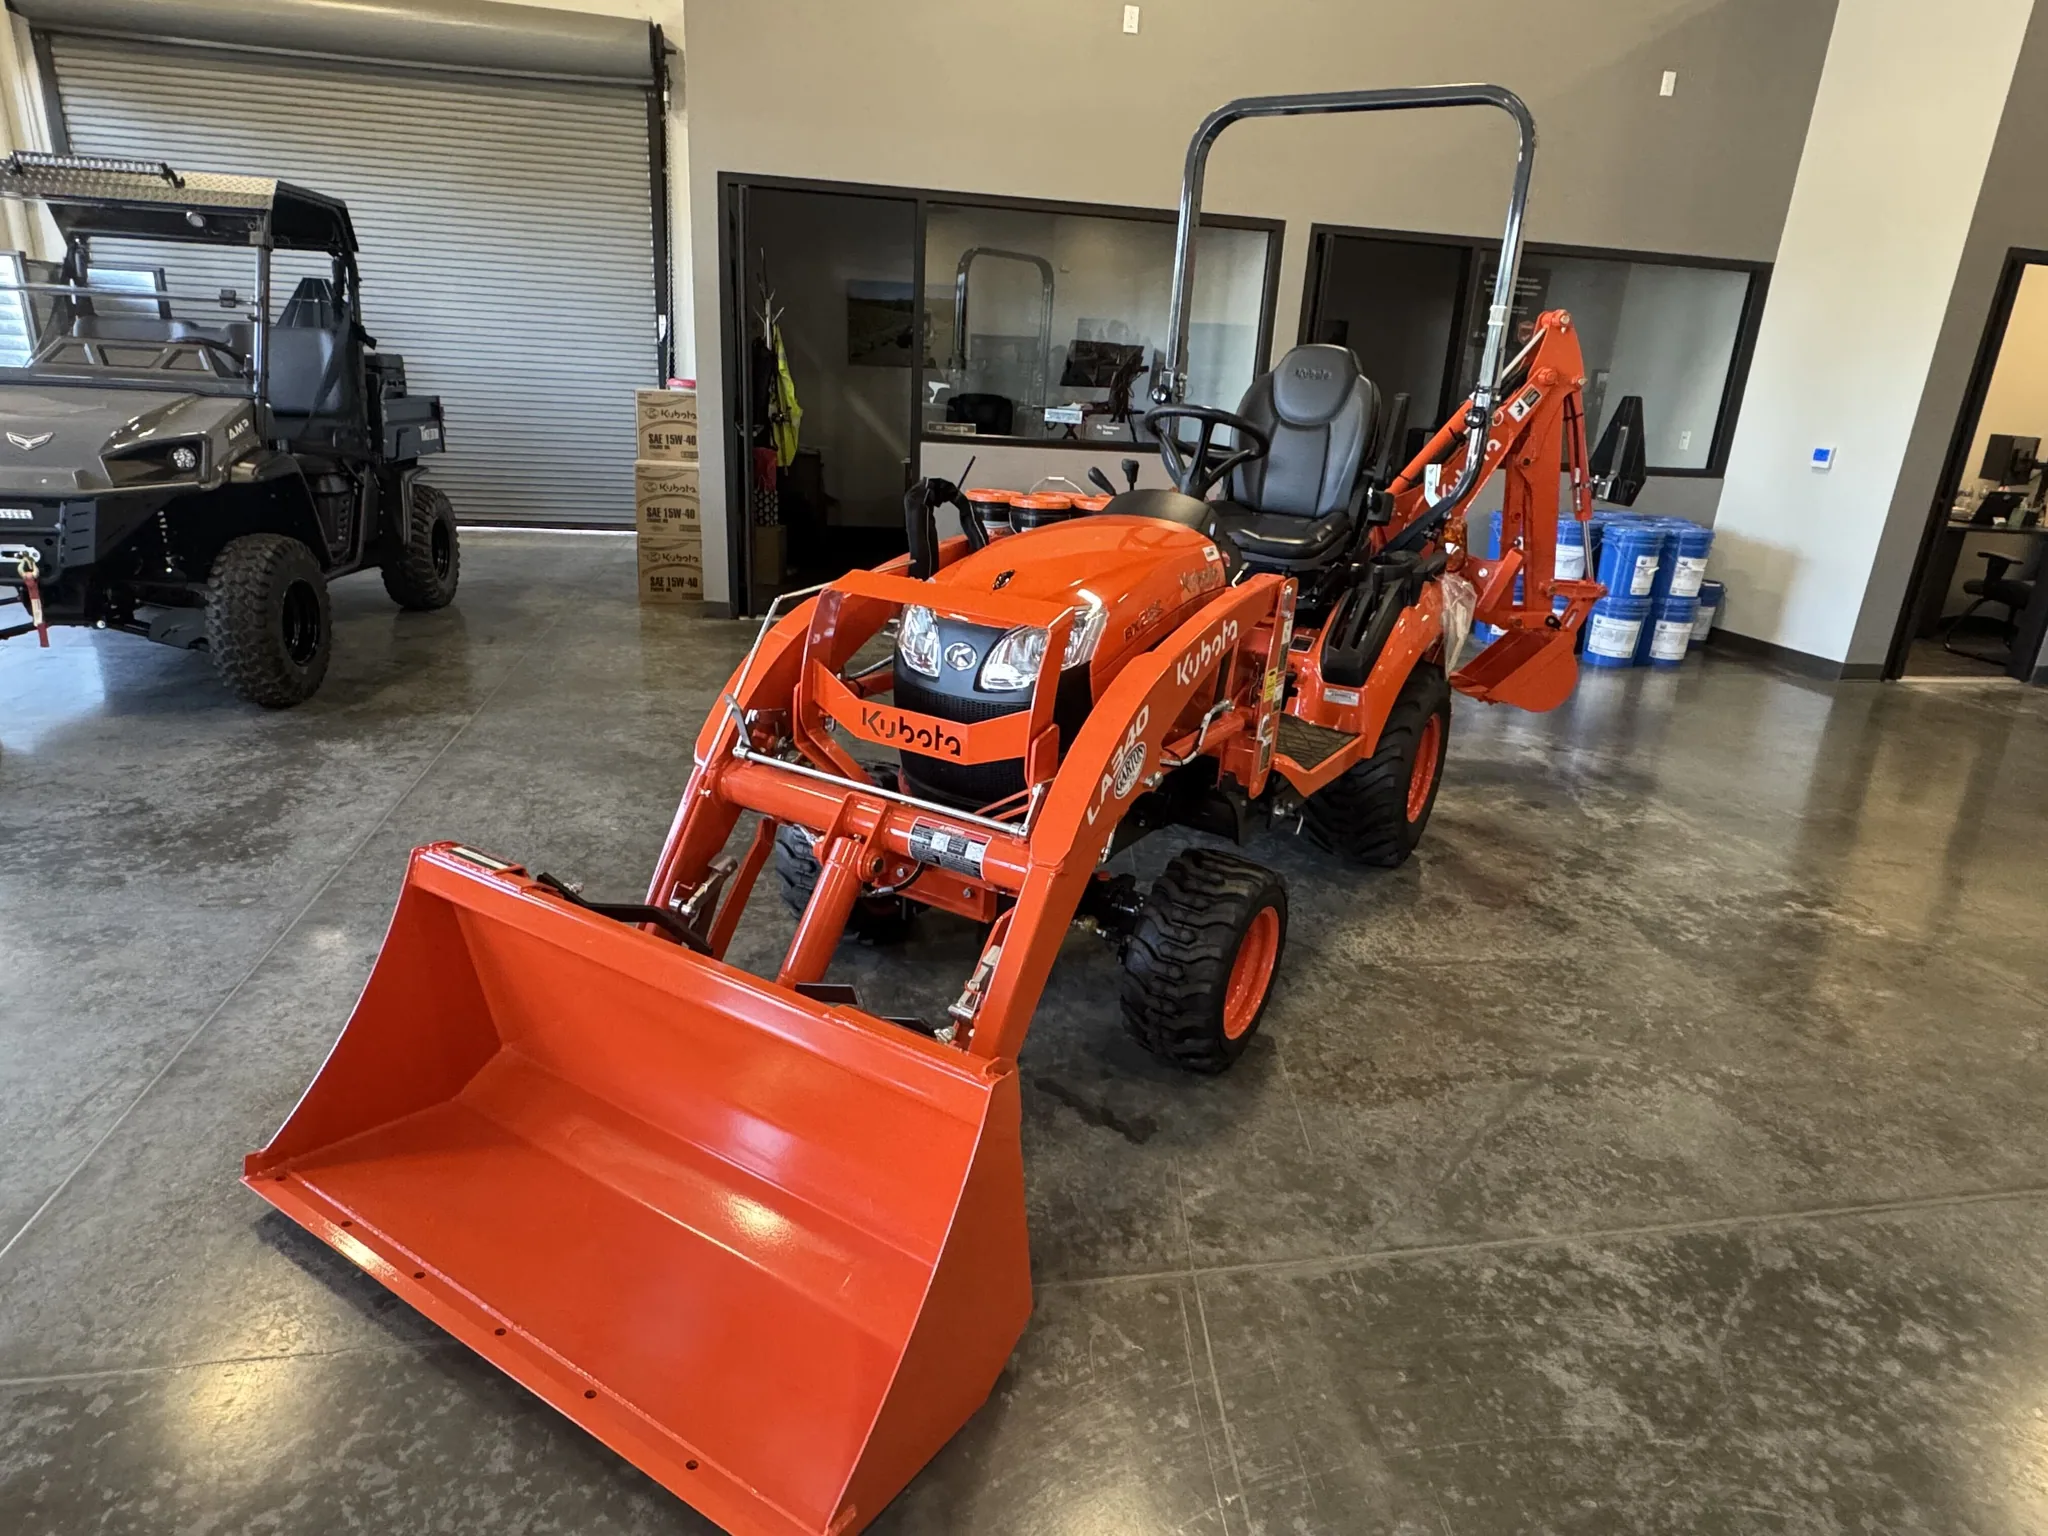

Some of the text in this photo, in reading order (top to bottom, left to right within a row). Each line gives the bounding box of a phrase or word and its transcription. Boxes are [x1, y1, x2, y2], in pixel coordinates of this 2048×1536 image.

[661, 409, 697, 419] Kubota
[648, 433, 697, 446] SAE 15W-40
[659, 483, 697, 493] Kubota
[647, 507, 695, 519] SAE 15W-40
[662, 553, 699, 562] Kubota
[650, 576, 698, 588] SAE 15W-40
[1176, 619, 1238, 686] Kubota
[862, 707, 961, 756] Kubota
[1087, 704, 1149, 825] LA340
